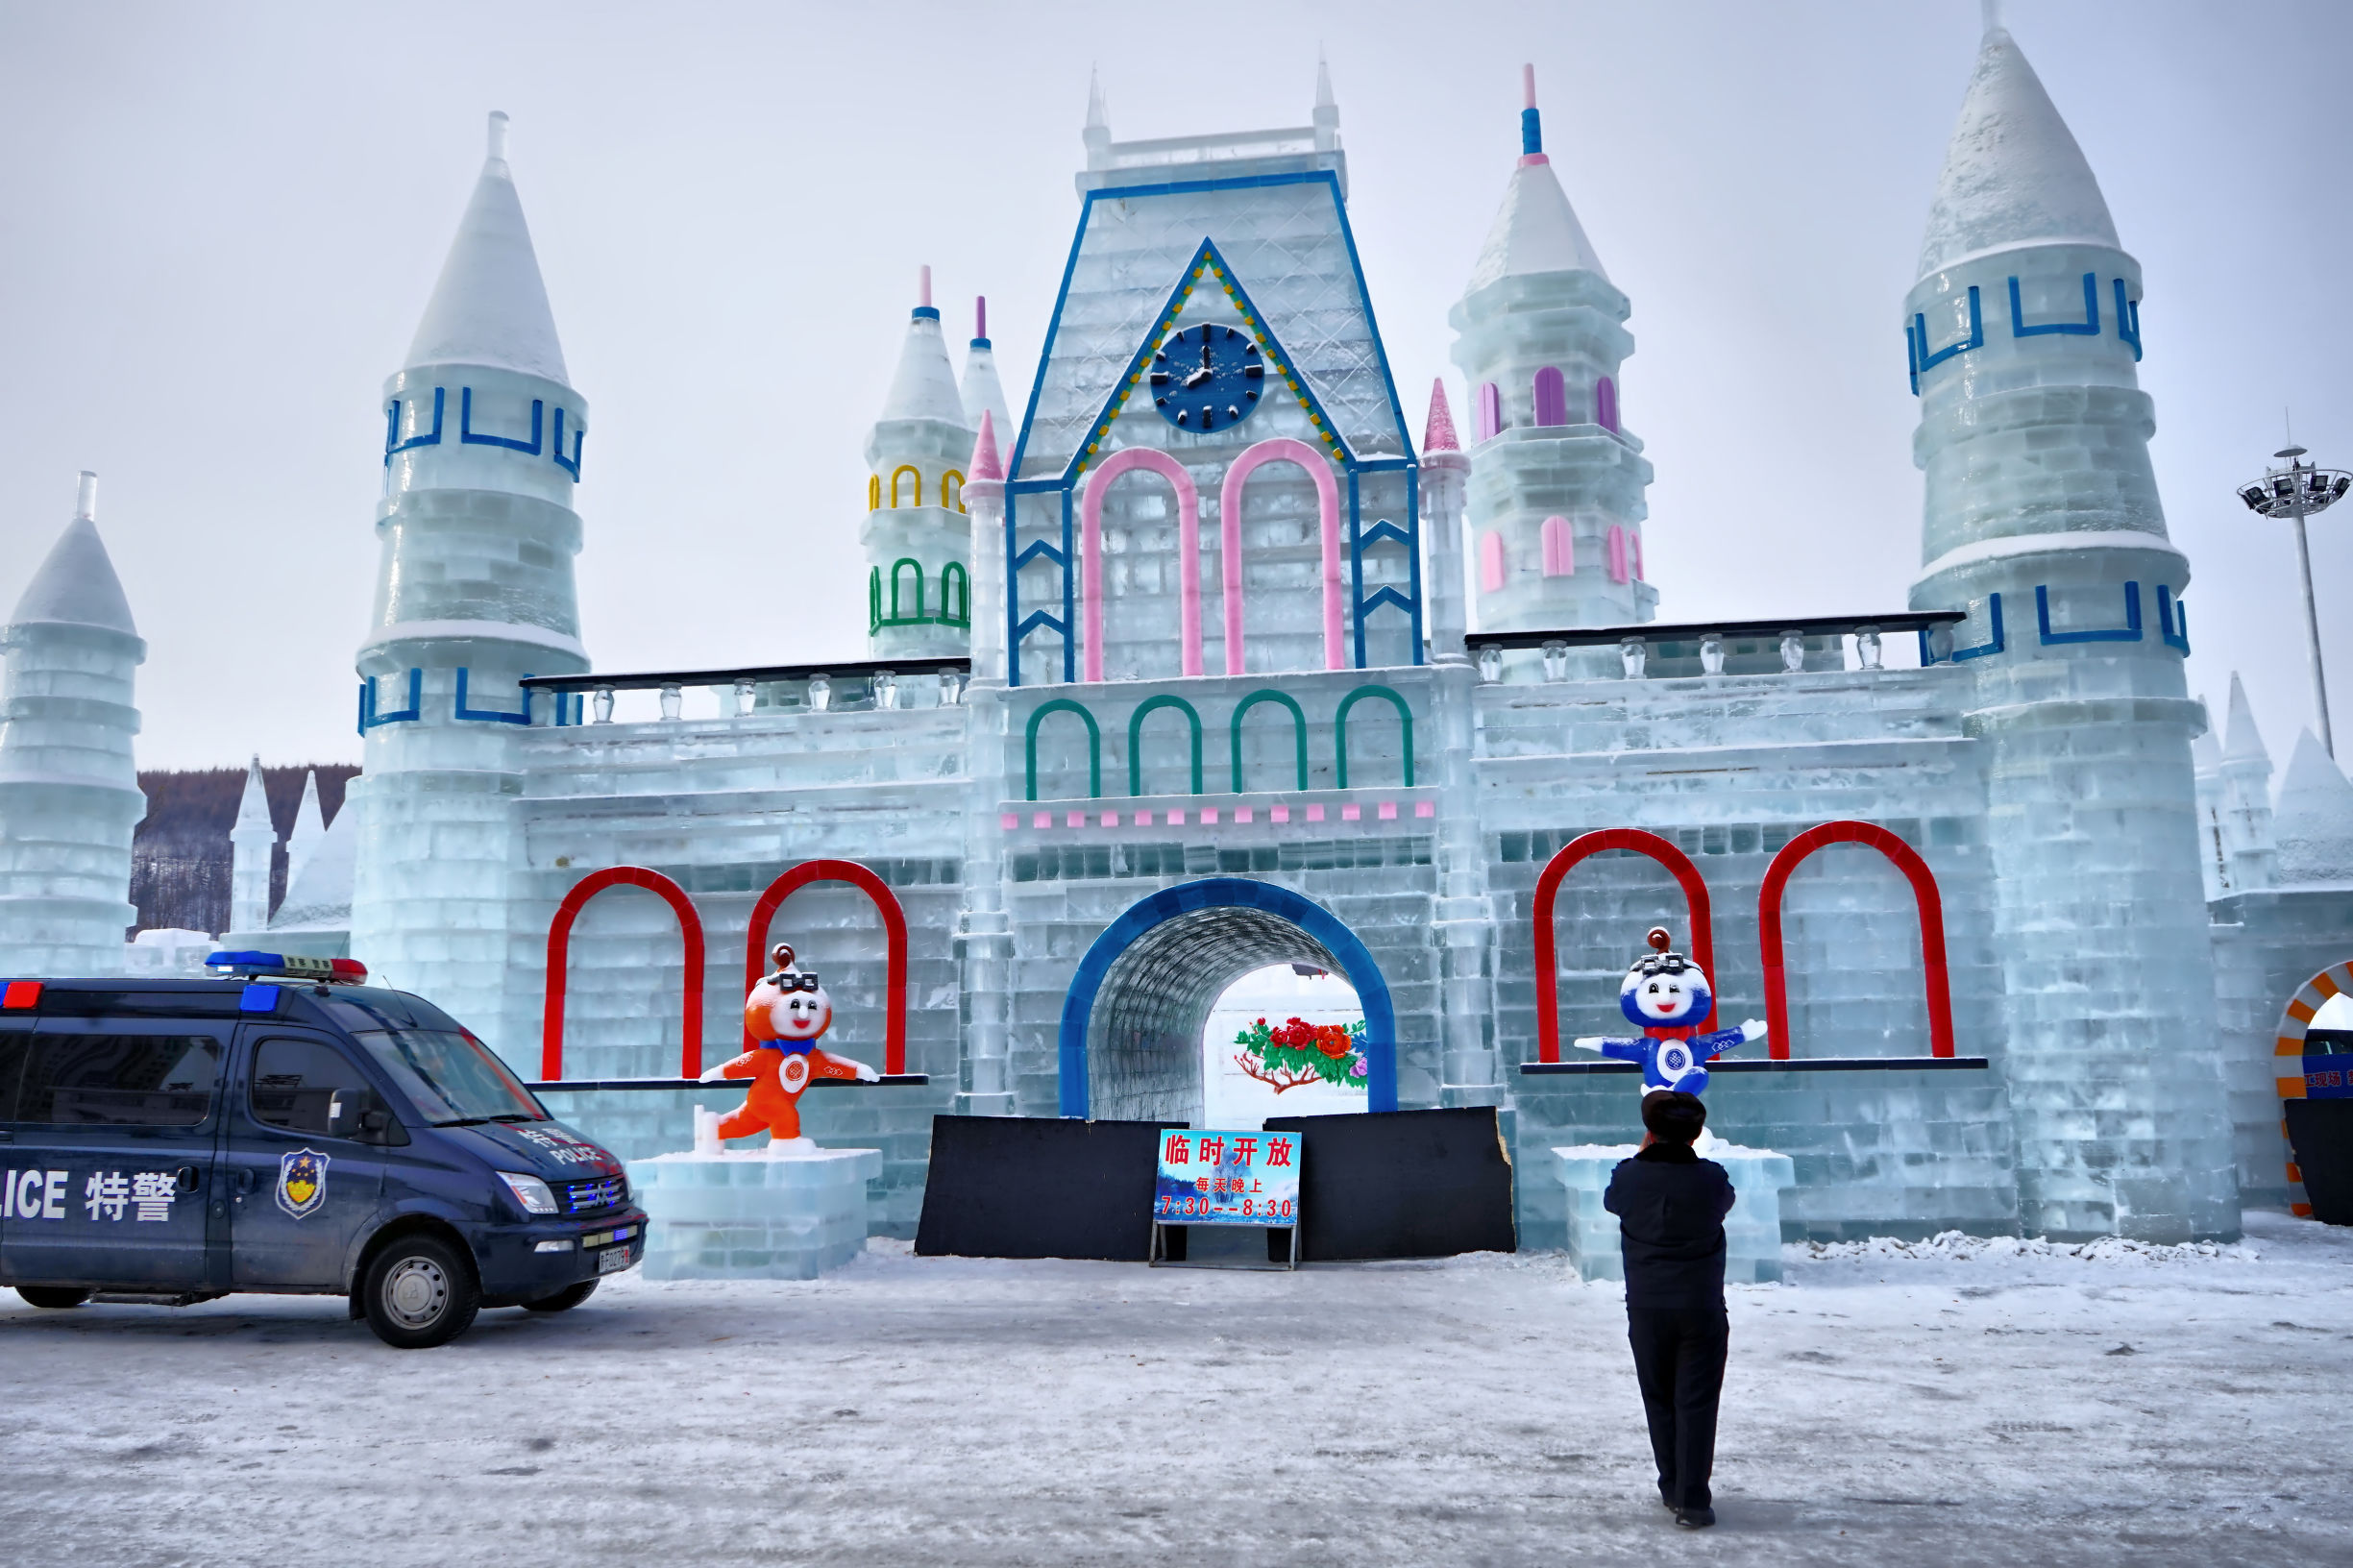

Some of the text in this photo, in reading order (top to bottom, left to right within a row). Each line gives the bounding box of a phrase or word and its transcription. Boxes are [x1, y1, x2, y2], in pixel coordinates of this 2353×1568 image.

[549, 1146, 602, 1165] POLICE
[1164, 1134, 1293, 1166] 临时开放
[0, 1169, 177, 1222] ICE 特警
[1195, 1176, 1263, 1194] 每天晚上
[1162, 1196, 1291, 1217] 7:30--8:30
